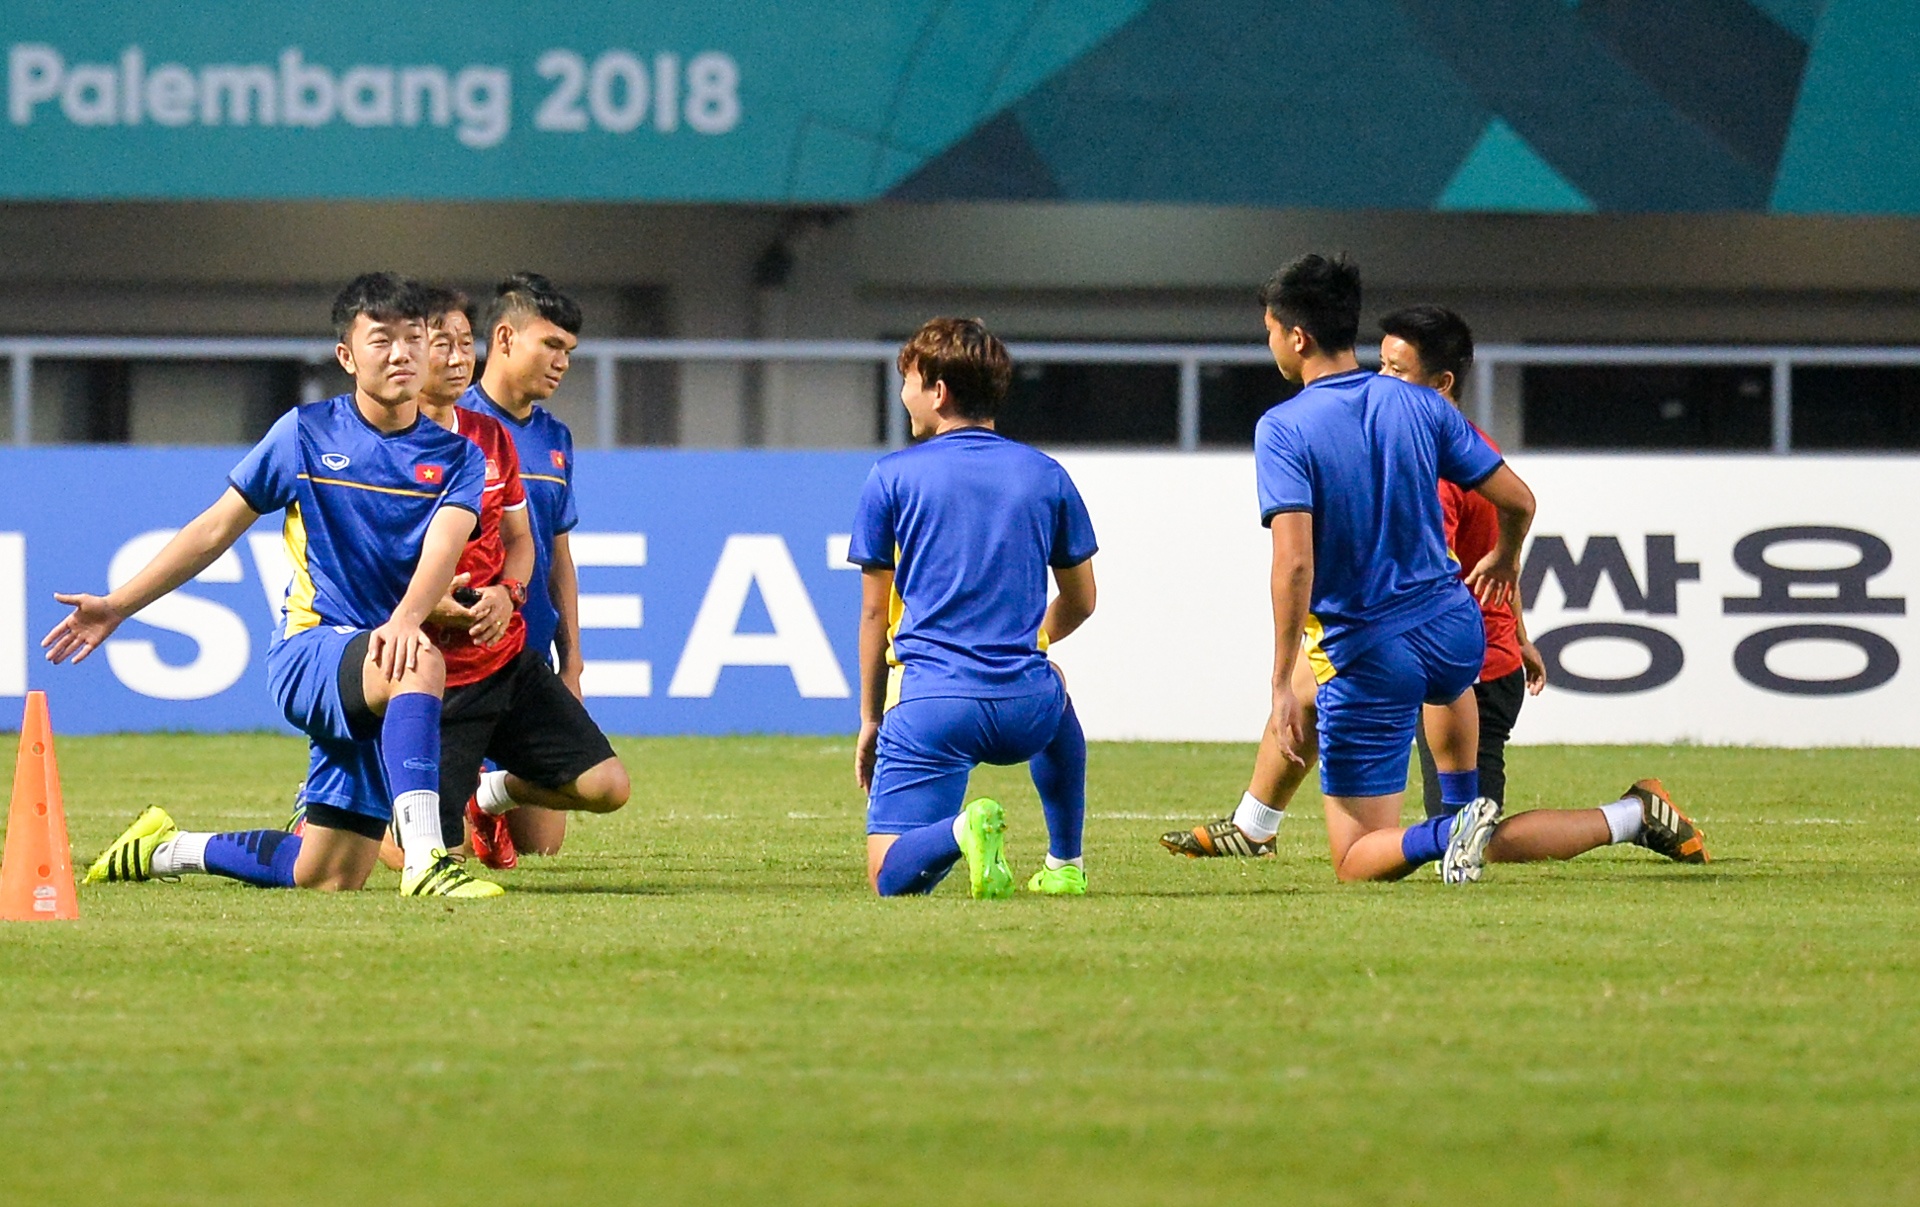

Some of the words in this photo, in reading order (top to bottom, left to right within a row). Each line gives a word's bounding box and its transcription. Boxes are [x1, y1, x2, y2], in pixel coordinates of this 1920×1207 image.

[9, 45, 511, 147] Palembang
[534, 50, 741, 133] 2018
[105, 529, 861, 700] SEA
[1521, 525, 1906, 695] 쌍용
